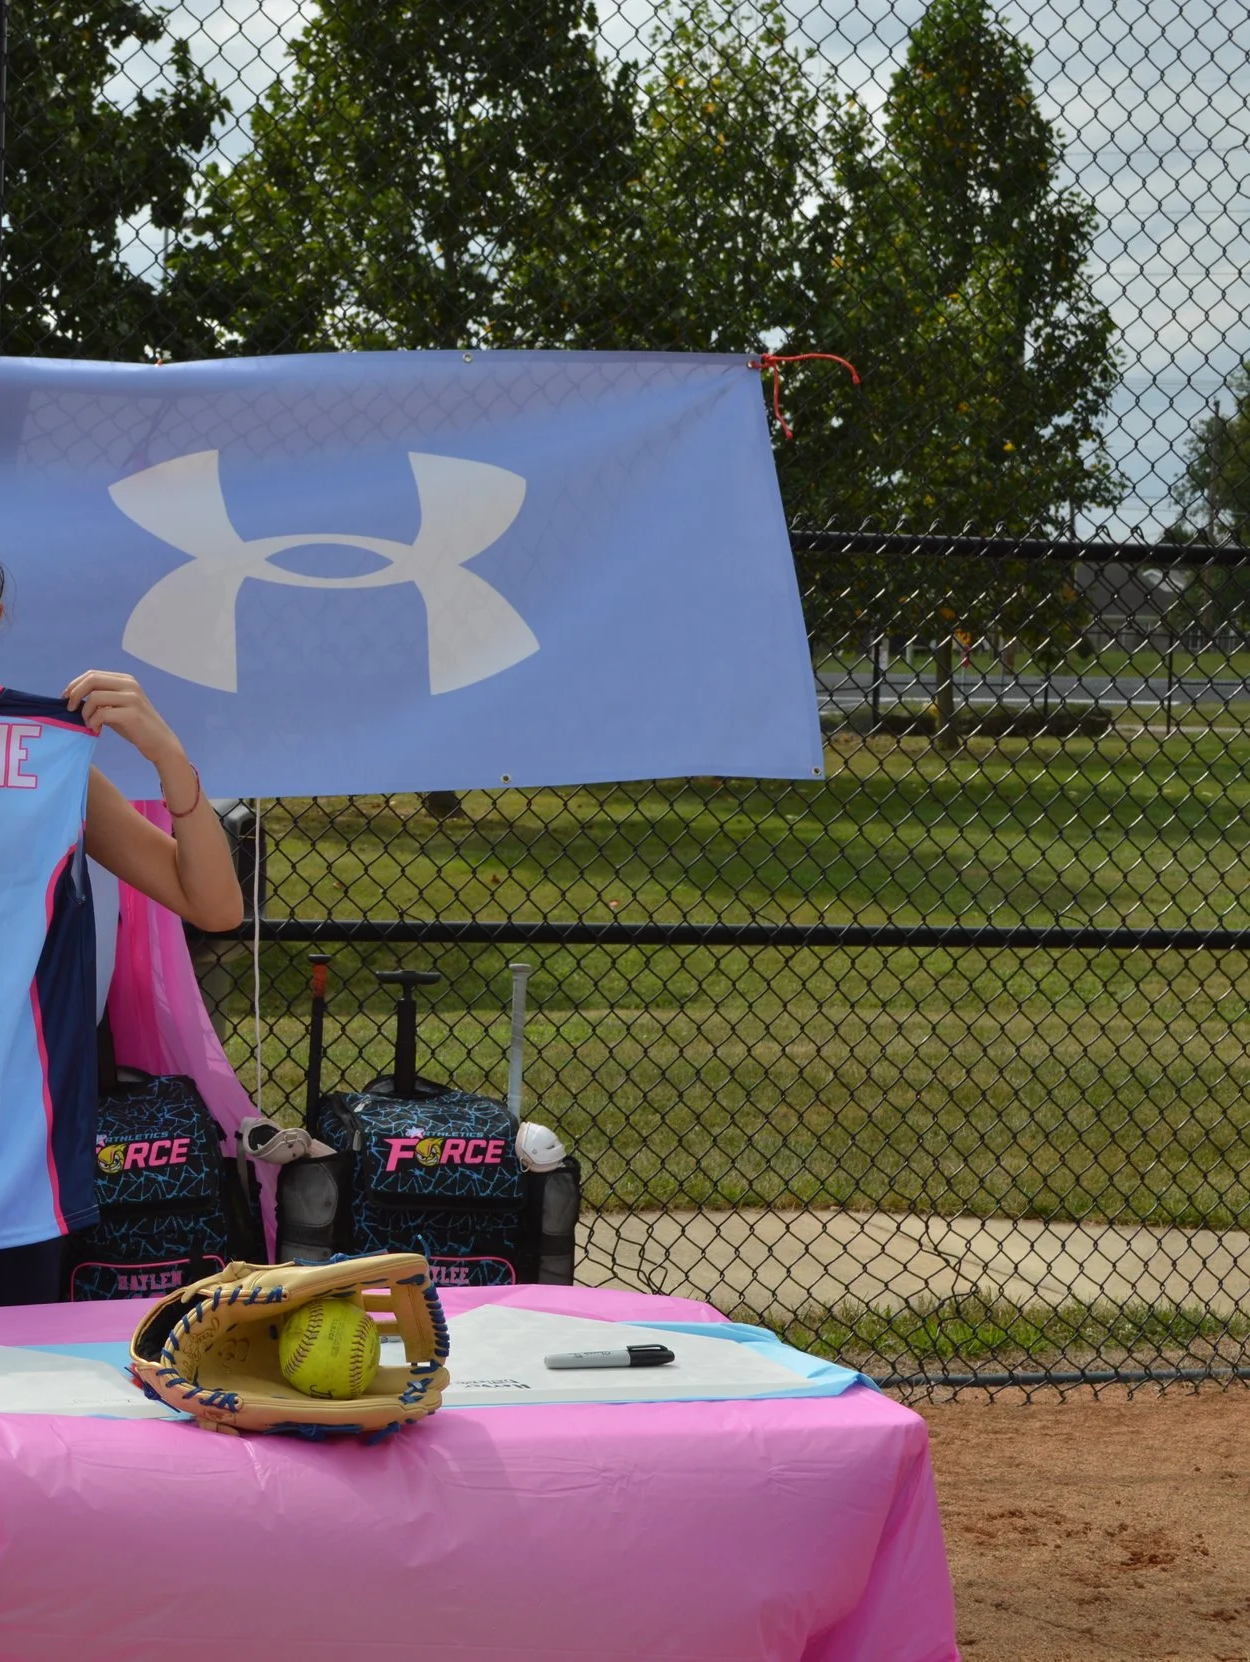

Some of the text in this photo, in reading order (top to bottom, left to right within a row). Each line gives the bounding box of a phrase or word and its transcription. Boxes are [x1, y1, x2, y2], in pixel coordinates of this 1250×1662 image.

[106, 1131, 170, 1143] ATHLETICS
[423, 1130, 484, 1138] ATHLETICS
[383, 1138, 505, 1172] FORCE
